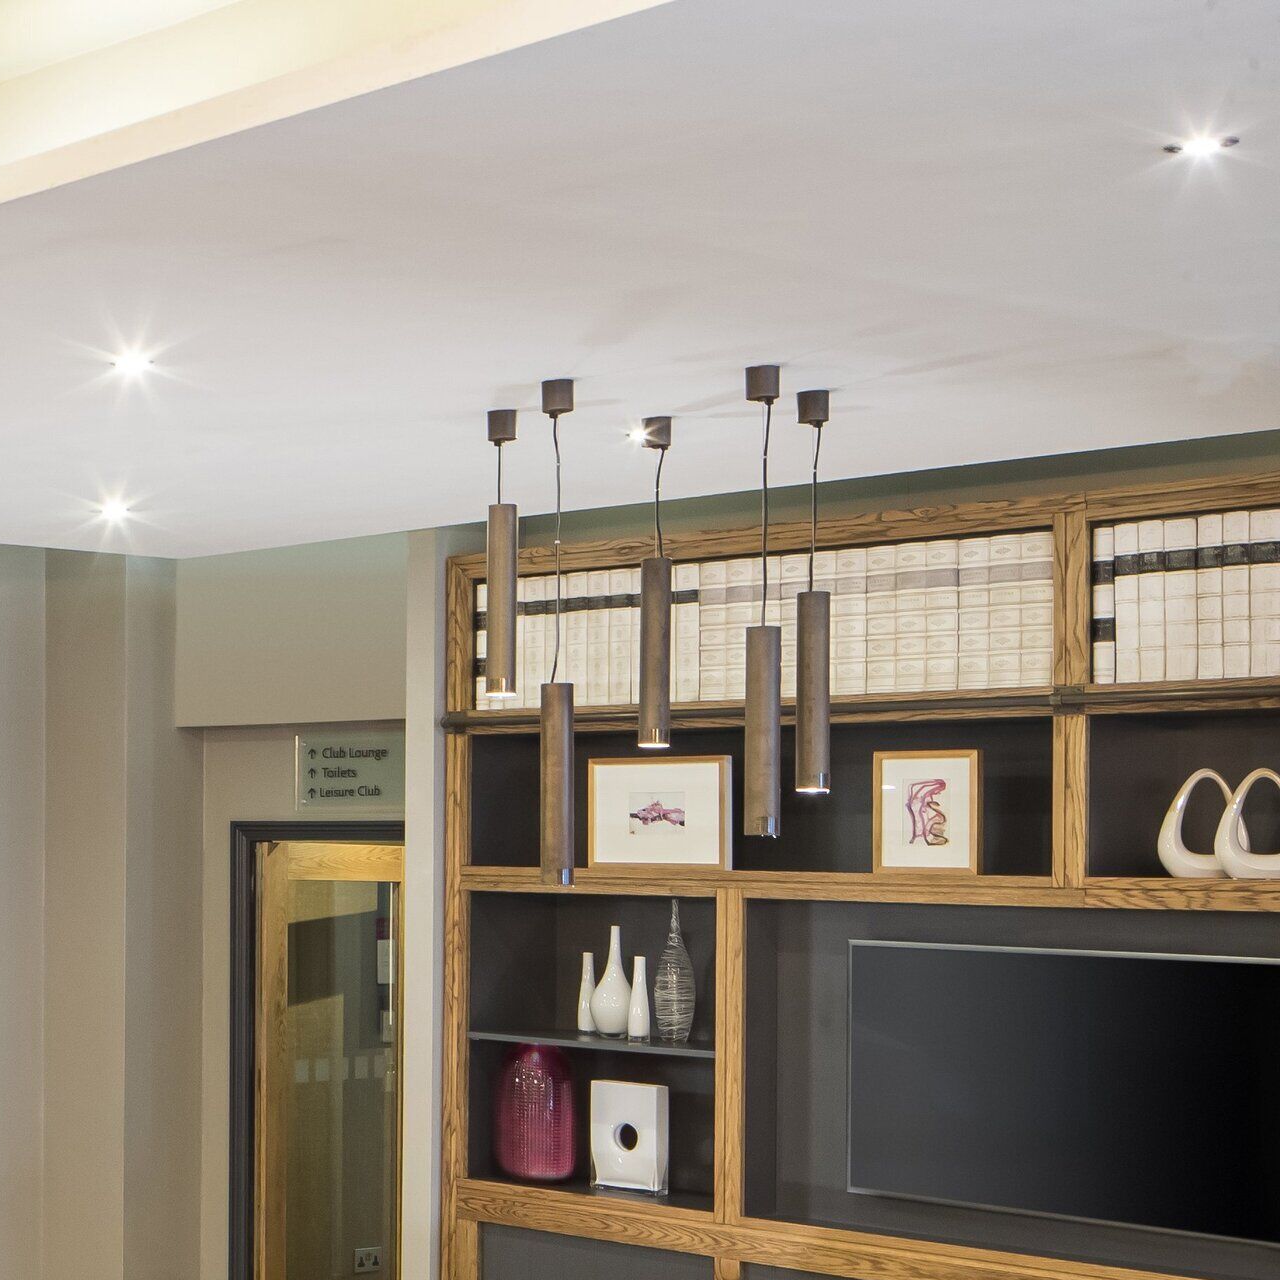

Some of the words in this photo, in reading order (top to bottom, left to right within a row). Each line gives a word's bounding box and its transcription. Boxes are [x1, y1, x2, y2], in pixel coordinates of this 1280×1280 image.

[321, 747, 346, 759] Club
[349, 748, 388, 761] Lounge
[321, 767, 358, 778] Toilets
[319, 787, 355, 798] Leisure
[357, 785, 381, 796] Club
